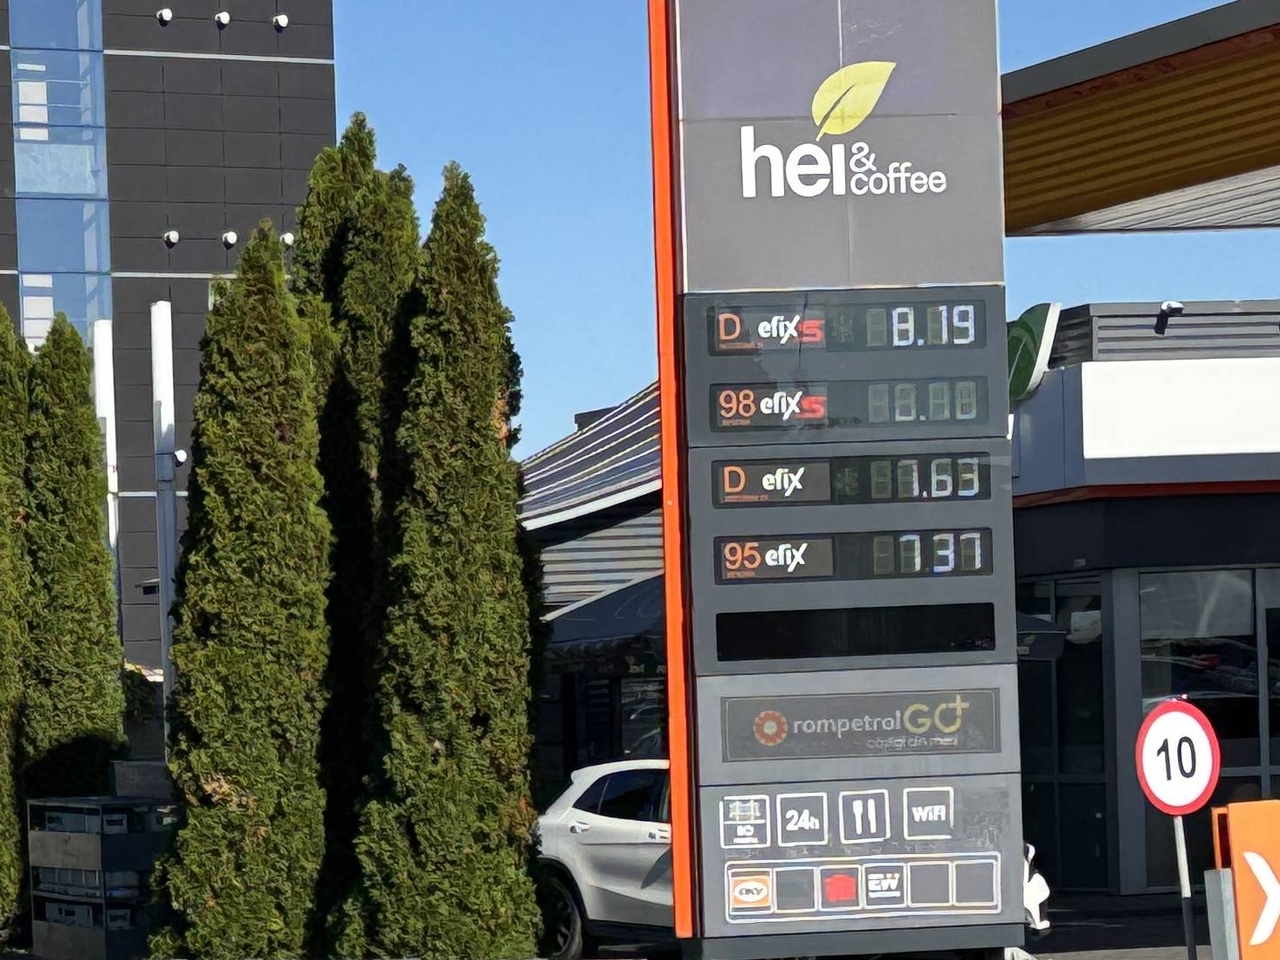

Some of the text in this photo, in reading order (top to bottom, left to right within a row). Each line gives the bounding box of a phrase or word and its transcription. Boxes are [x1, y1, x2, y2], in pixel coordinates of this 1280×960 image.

[849, 141, 877, 172] &
[850, 162, 947, 195] coffee
[718, 313, 741, 341] D
[892, 304, 976, 347] 8.19
[718, 389, 756, 418] 98
[722, 465, 805, 497] D efix
[723, 542, 809, 573] 95 efix
[1156, 736, 1197, 781] 10
[785, 809, 820, 831] 24h
